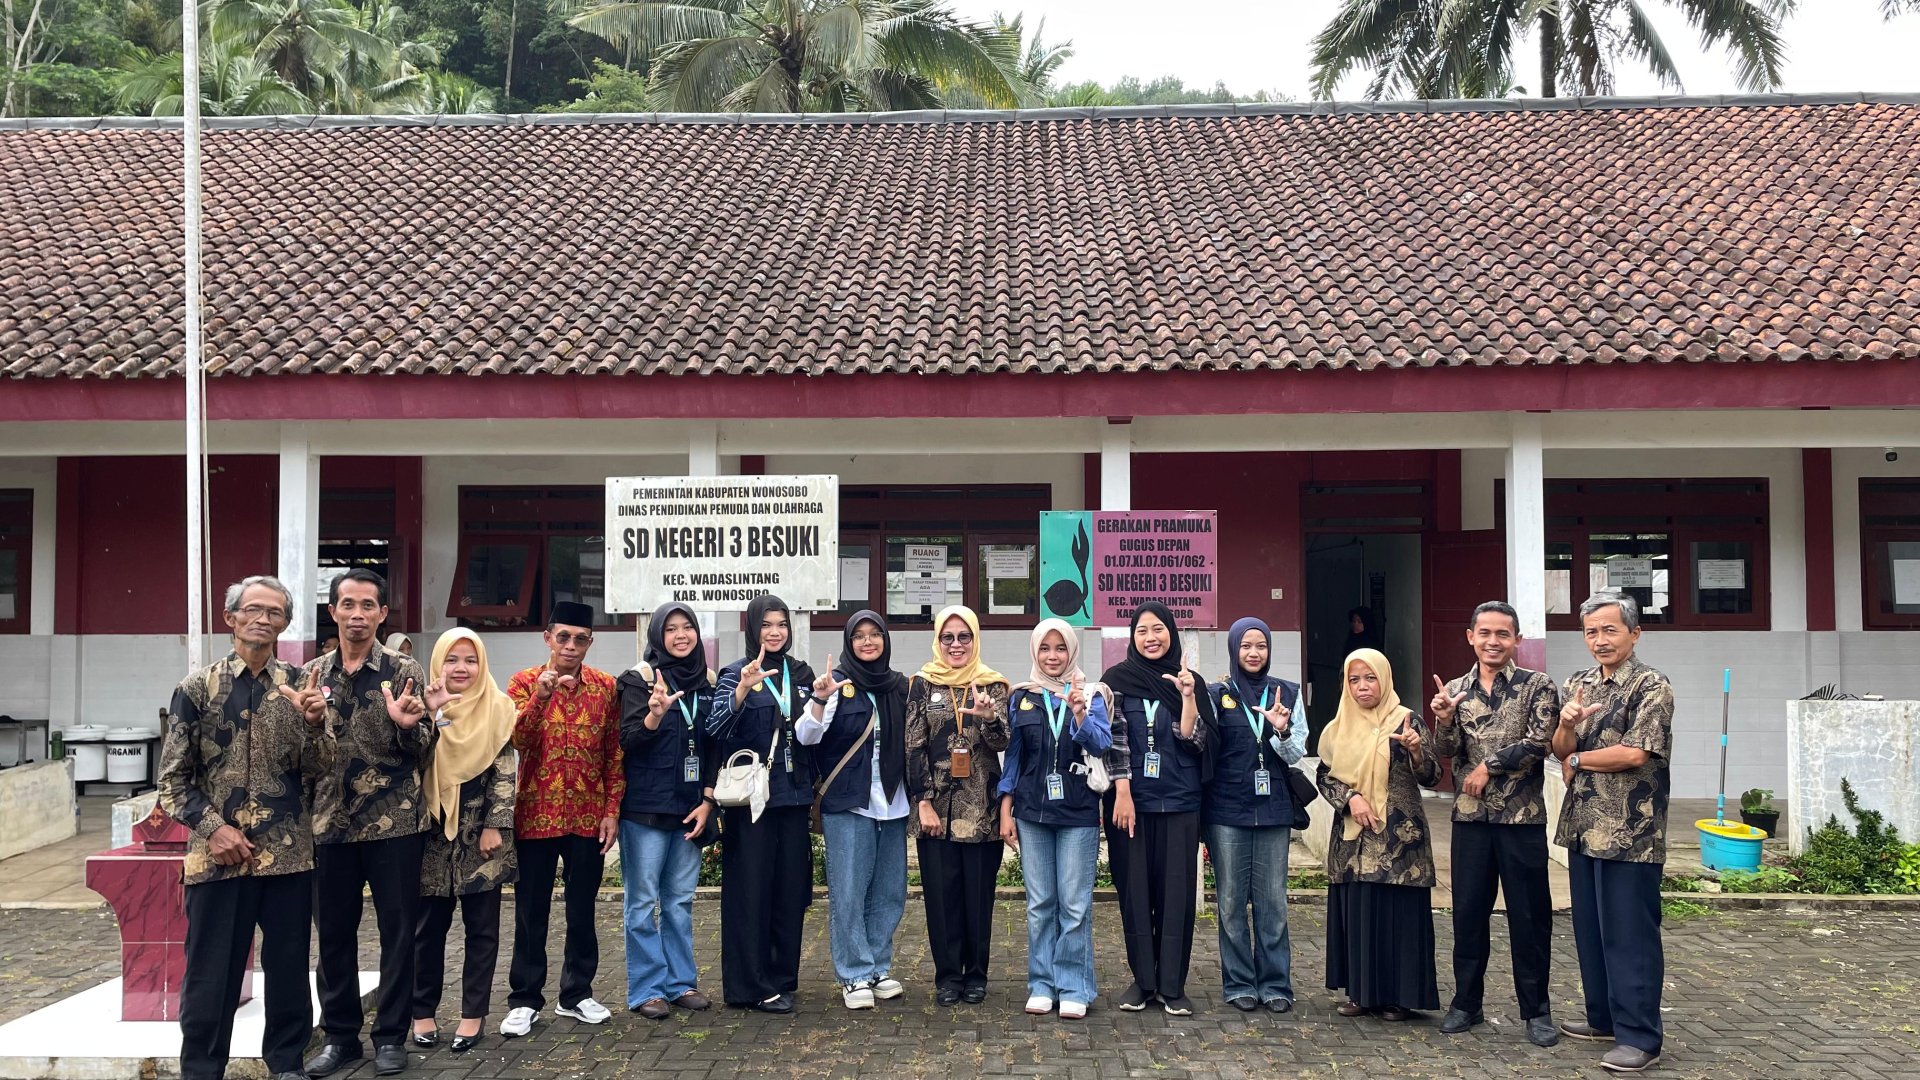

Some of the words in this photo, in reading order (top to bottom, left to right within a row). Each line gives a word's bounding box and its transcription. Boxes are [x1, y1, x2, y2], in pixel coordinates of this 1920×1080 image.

[633, 488, 692, 499] PEMERINTAH
[695, 487, 749, 498] KABUPATEN
[752, 486, 807, 497] WONOSOBO
[618, 505, 647, 516] DINAS
[650, 504, 707, 515] PENDIDIKAN
[710, 504, 749, 514] PEMUDA
[752, 503, 770, 514] DAN
[773, 502, 823, 514] OLAHRAGA
[1098, 519, 1150, 533] GERAKAN
[1154, 519, 1212, 533] PRAMUKA
[623, 528, 649, 559] SD
[656, 527, 723, 558] NEGERI
[730, 526, 742, 557] 3
[748, 525, 819, 557] BESUKI
[1120, 539, 1155, 551] GUGUS
[1158, 539, 1190, 551] DEPAN
[913, 549, 940, 557] RUANG
[1104, 555, 1205, 568] 01.07.XI.07.061/062
[663, 574, 687, 585] KEC.
[690, 573, 779, 585] WADASLINTANG
[1098, 574, 1113, 591] SD
[1117, 574, 1156, 591] NEGERI
[1160, 574, 1166, 591] 3
[1170, 574, 1212, 591] BESUKI
[673, 590, 699, 601] KAB.
[1108, 597, 1128, 606] KEC.
